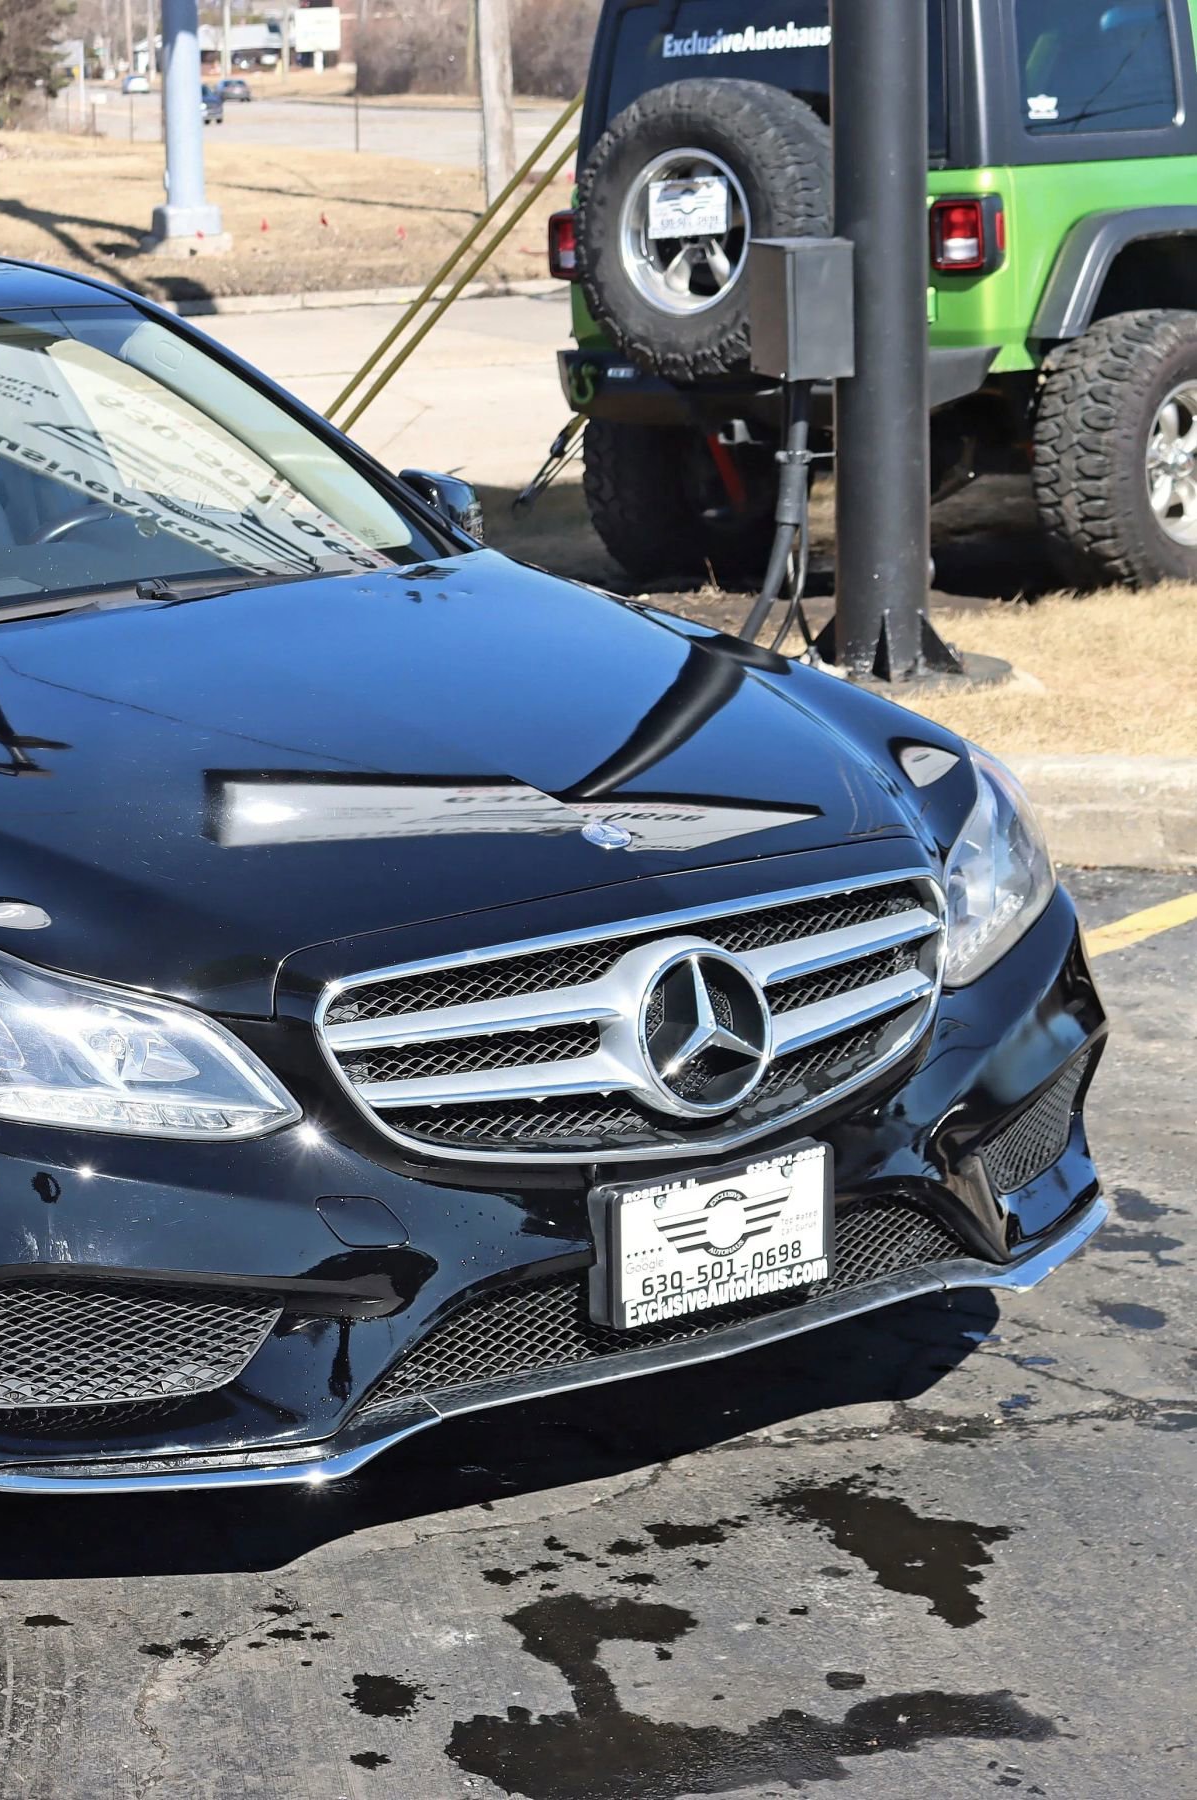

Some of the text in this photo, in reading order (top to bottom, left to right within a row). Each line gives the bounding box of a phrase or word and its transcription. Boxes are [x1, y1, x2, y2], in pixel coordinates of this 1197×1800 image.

[662, 21, 832, 58] ExclusiveAutohaus
[625, 1256, 665, 1275] Google
[642, 1240, 802, 1297] 630-501-0698
[625, 1257, 828, 1328] ExclusiveAutoHaus.com
